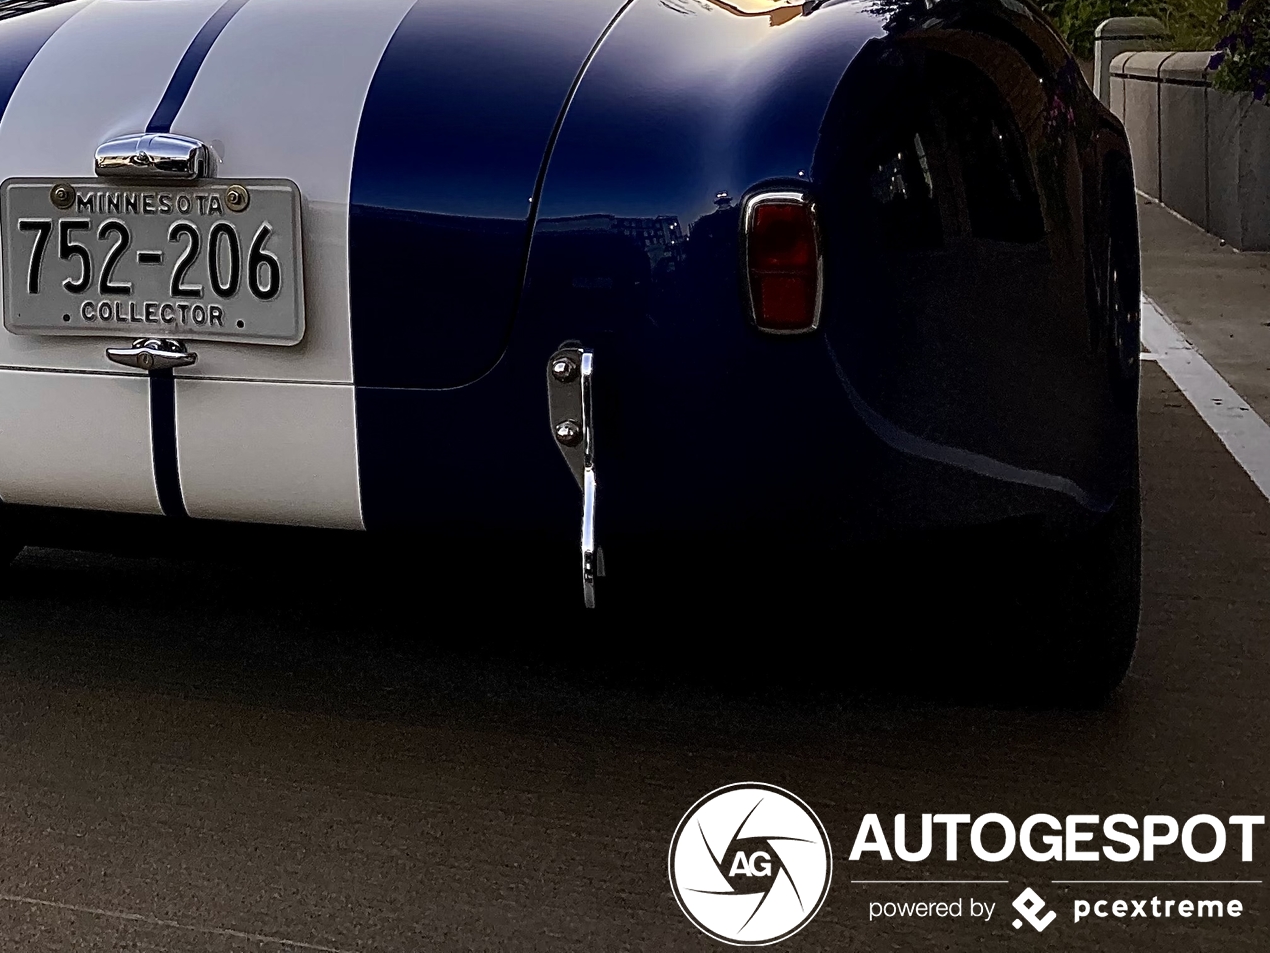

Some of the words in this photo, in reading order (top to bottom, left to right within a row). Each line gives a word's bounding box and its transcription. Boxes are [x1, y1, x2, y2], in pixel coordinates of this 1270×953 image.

[77, 191, 224, 216] MINNESOTA
[17, 218, 281, 301] 752-206
[80, 300, 224, 326] COLLECTOR
